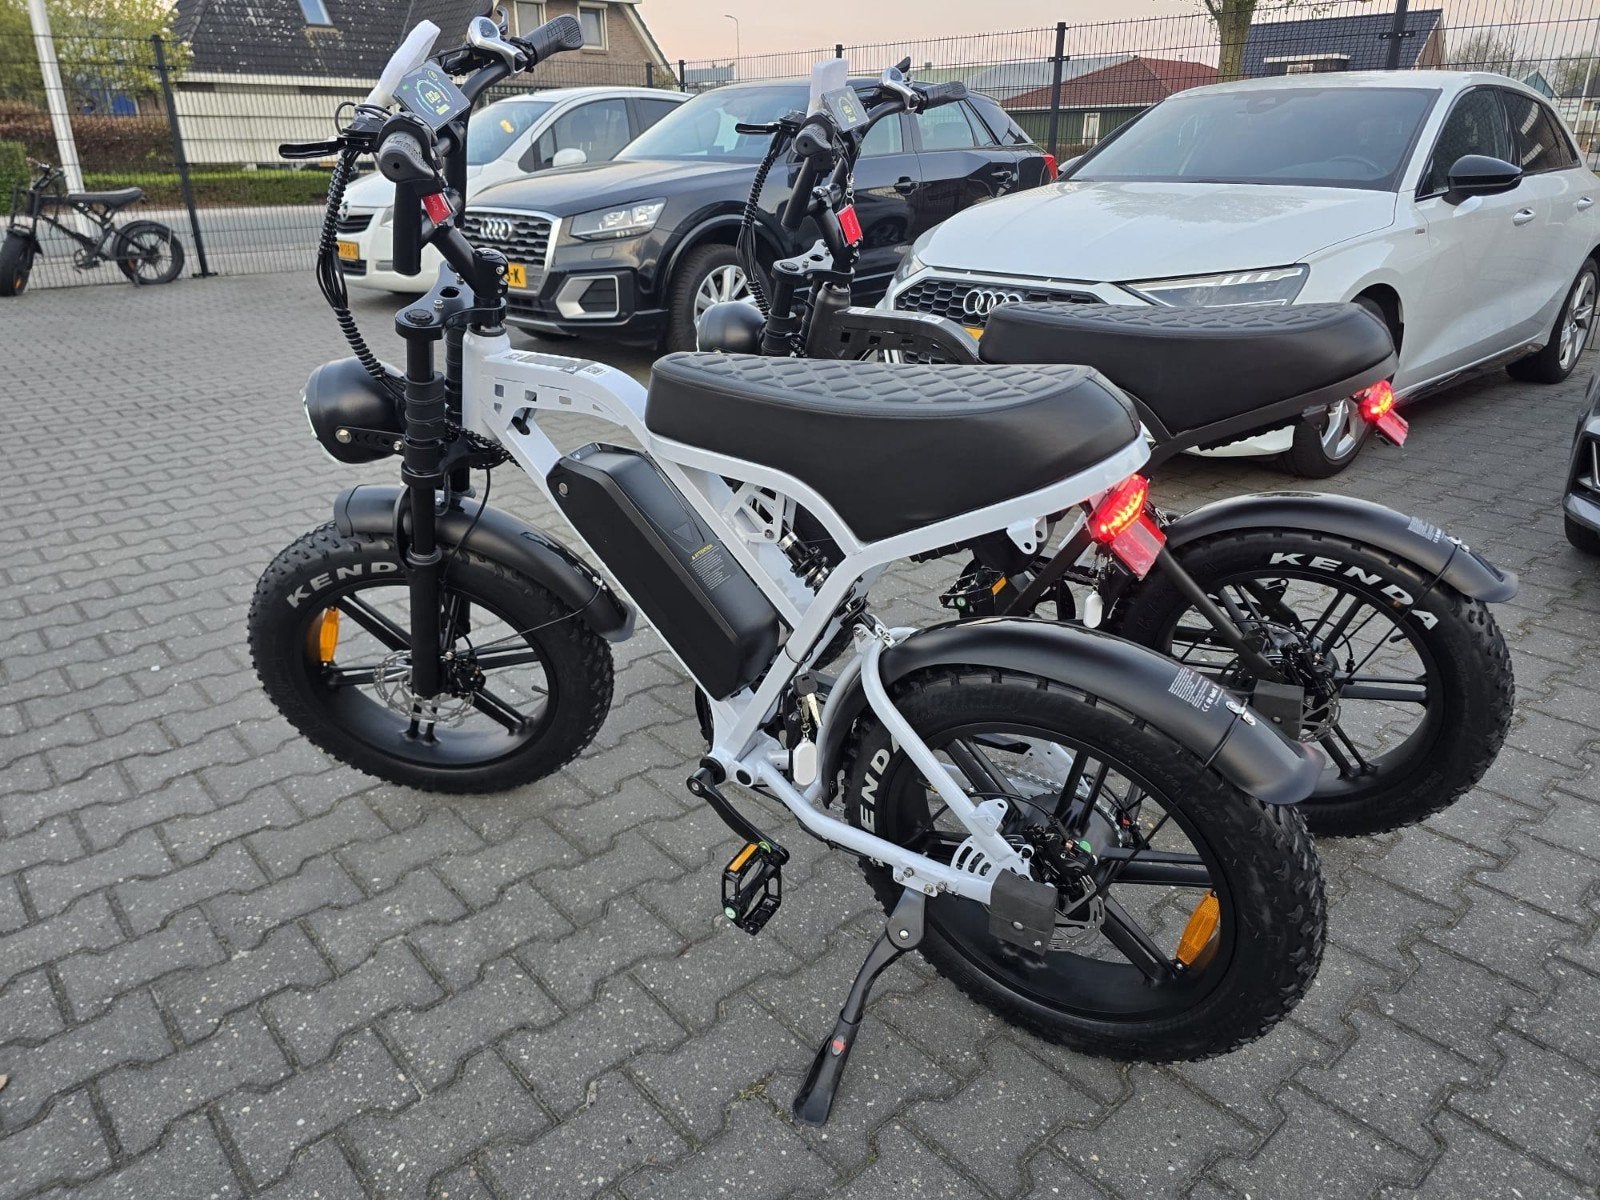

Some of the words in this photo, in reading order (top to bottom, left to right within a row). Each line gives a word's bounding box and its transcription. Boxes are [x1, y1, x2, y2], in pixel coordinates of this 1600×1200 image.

[286, 561, 398, 608] KEND
[1269, 552, 1439, 630] KENDA
[861, 734, 900, 836] END
